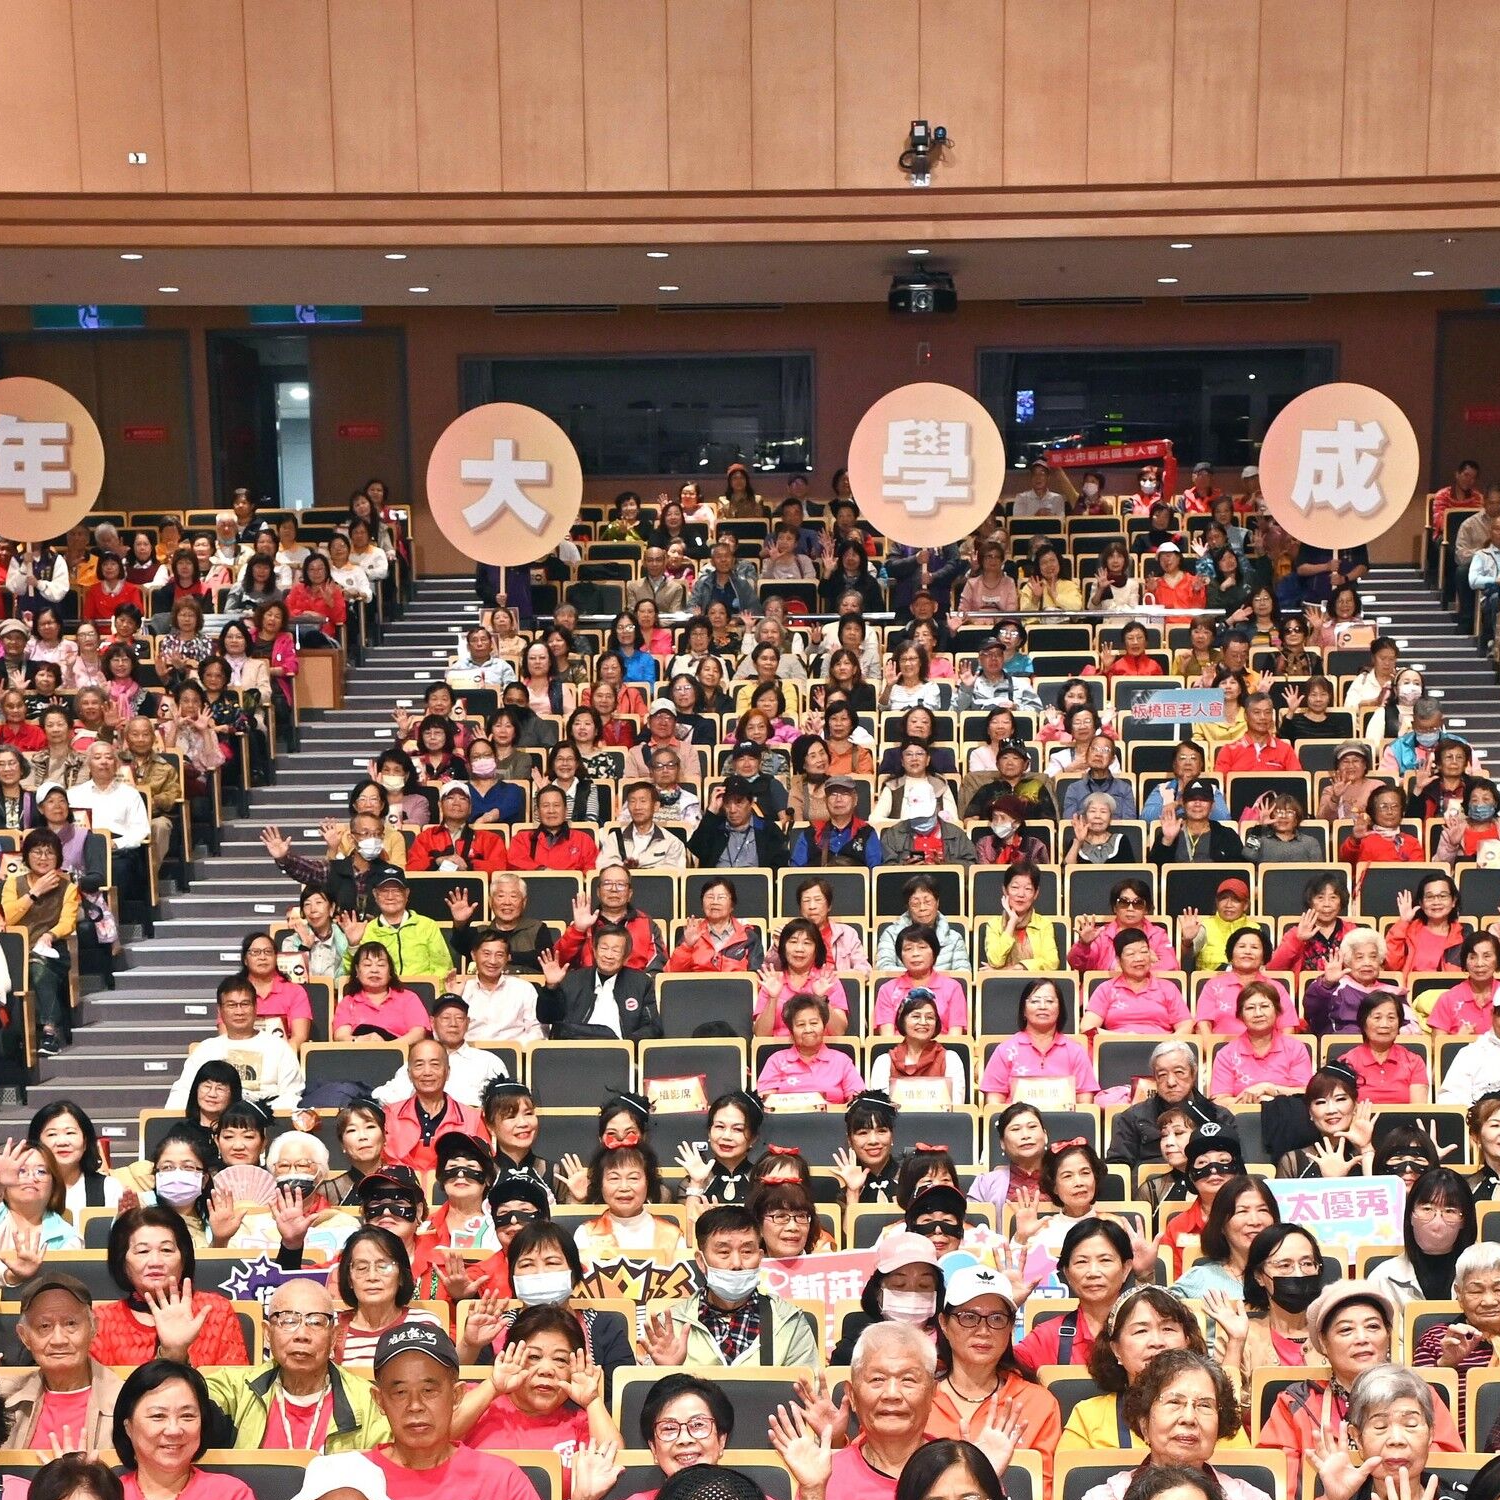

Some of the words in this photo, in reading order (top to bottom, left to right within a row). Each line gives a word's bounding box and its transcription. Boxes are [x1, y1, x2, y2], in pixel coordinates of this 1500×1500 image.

[460, 438, 551, 534] 大
[881, 418, 972, 516] 學
[1291, 420, 1386, 517] 成
[1133, 702, 1223, 720] 板橋區老人會
[1287, 1188, 1389, 1222] 太優秀
[790, 1269, 862, 1304] 新莊
